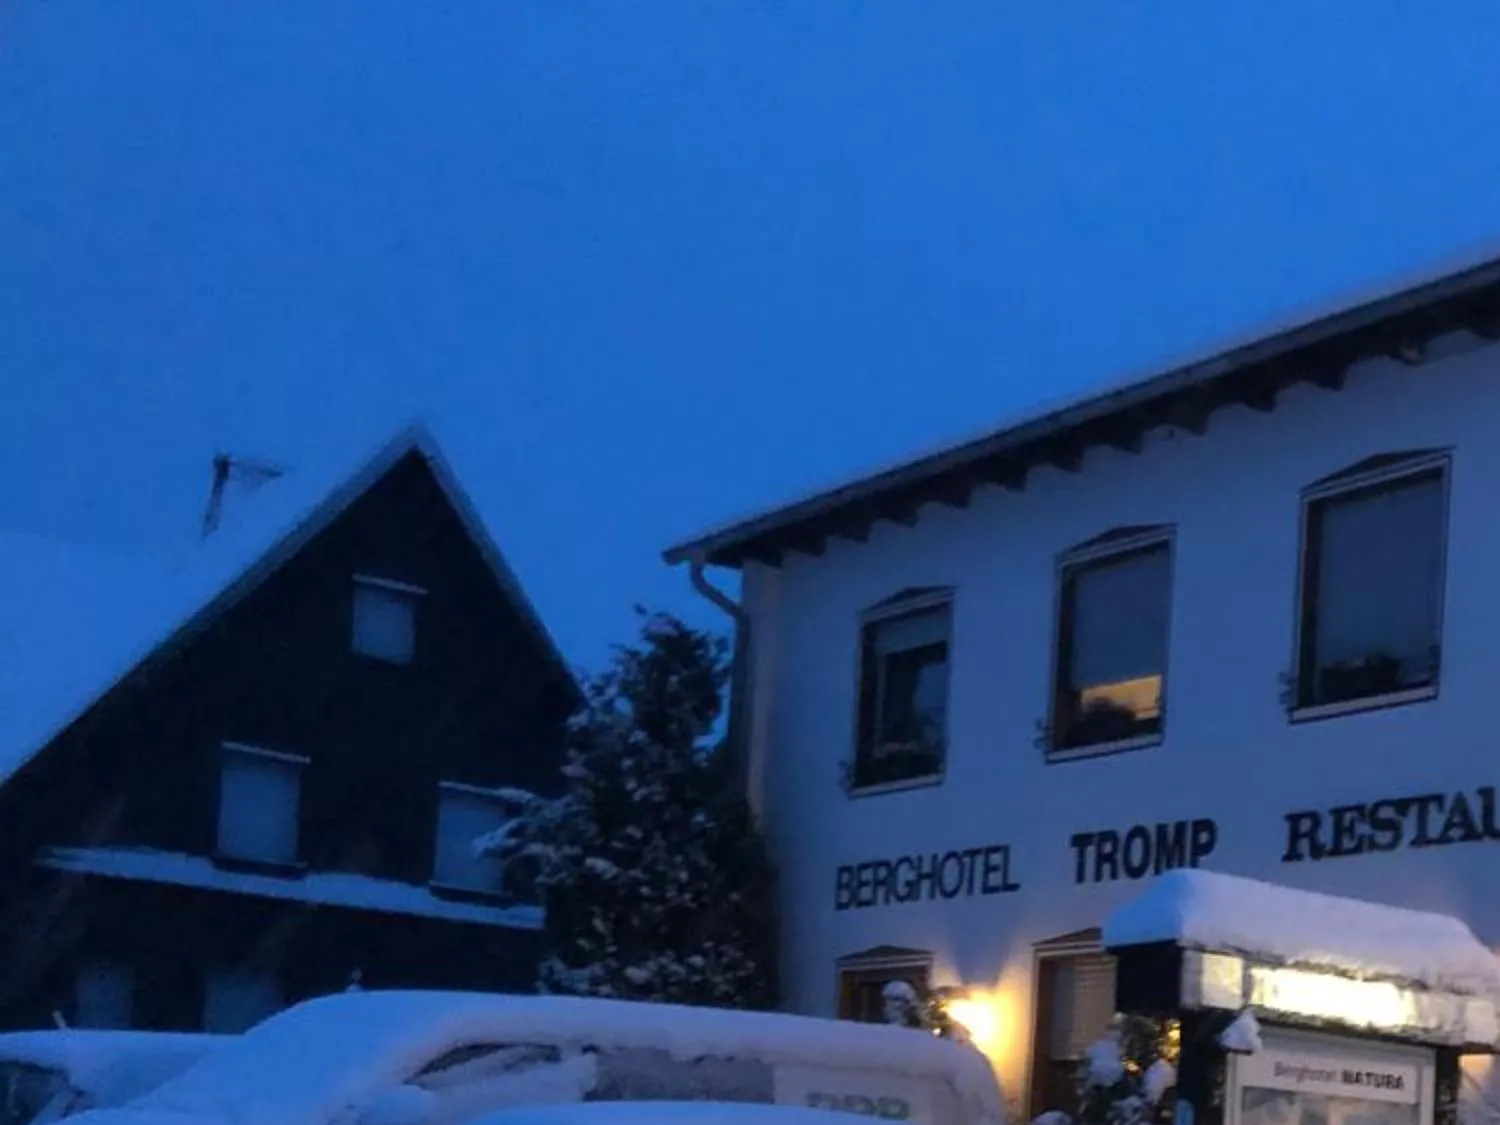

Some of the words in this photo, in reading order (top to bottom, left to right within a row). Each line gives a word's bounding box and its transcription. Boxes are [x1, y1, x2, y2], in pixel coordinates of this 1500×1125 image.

[834, 844, 1020, 911] BERGHOTEL
[1070, 819, 1217, 884] TROMP
[1341, 1069, 1405, 1090] NATURA
